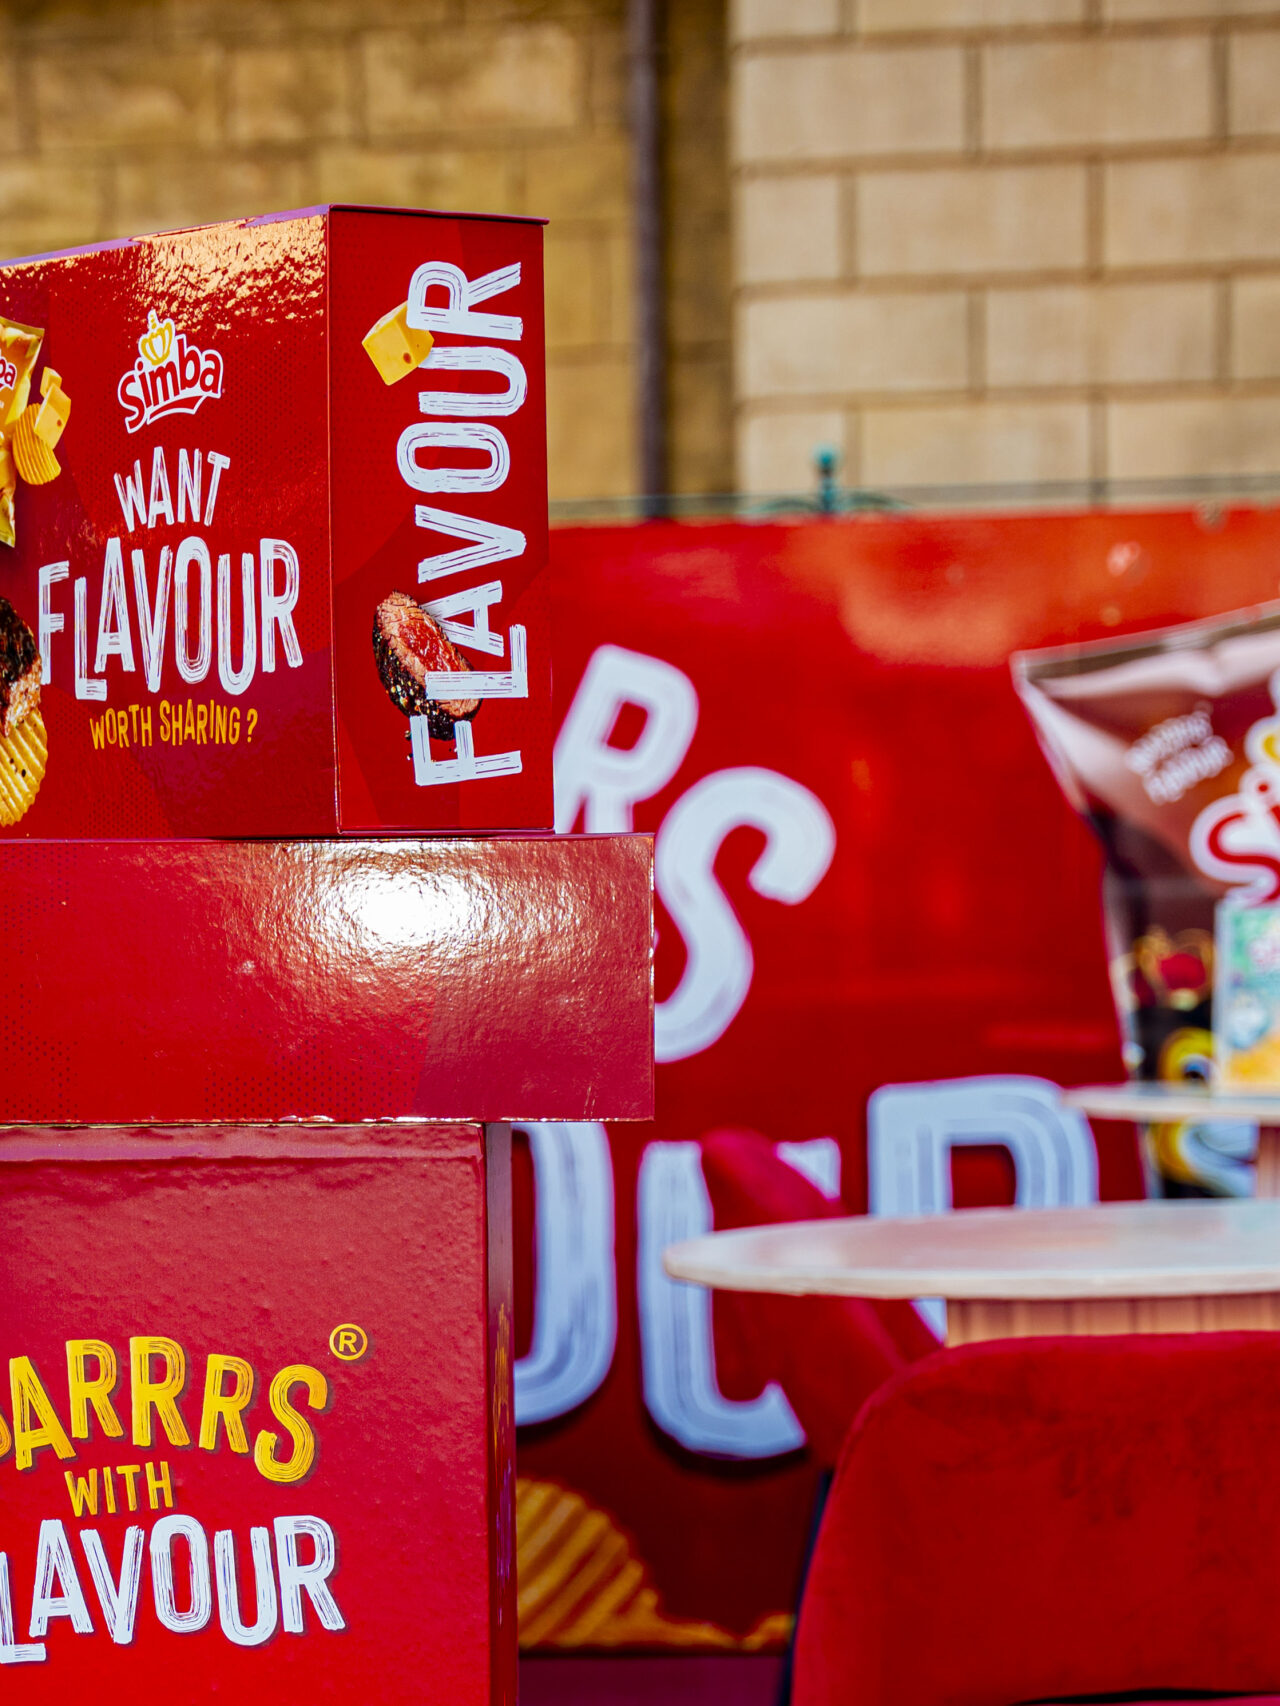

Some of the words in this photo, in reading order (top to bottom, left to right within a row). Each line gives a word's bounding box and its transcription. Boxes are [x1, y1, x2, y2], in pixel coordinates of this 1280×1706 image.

[118, 333, 223, 434] Simba
[114, 446, 230, 532] WANT
[397, 260, 528, 786] FLAVOUR
[39, 536, 303, 701] FLAVOUR
[90, 704, 153, 750] WORTH
[64, 1461, 174, 1517] WITH
